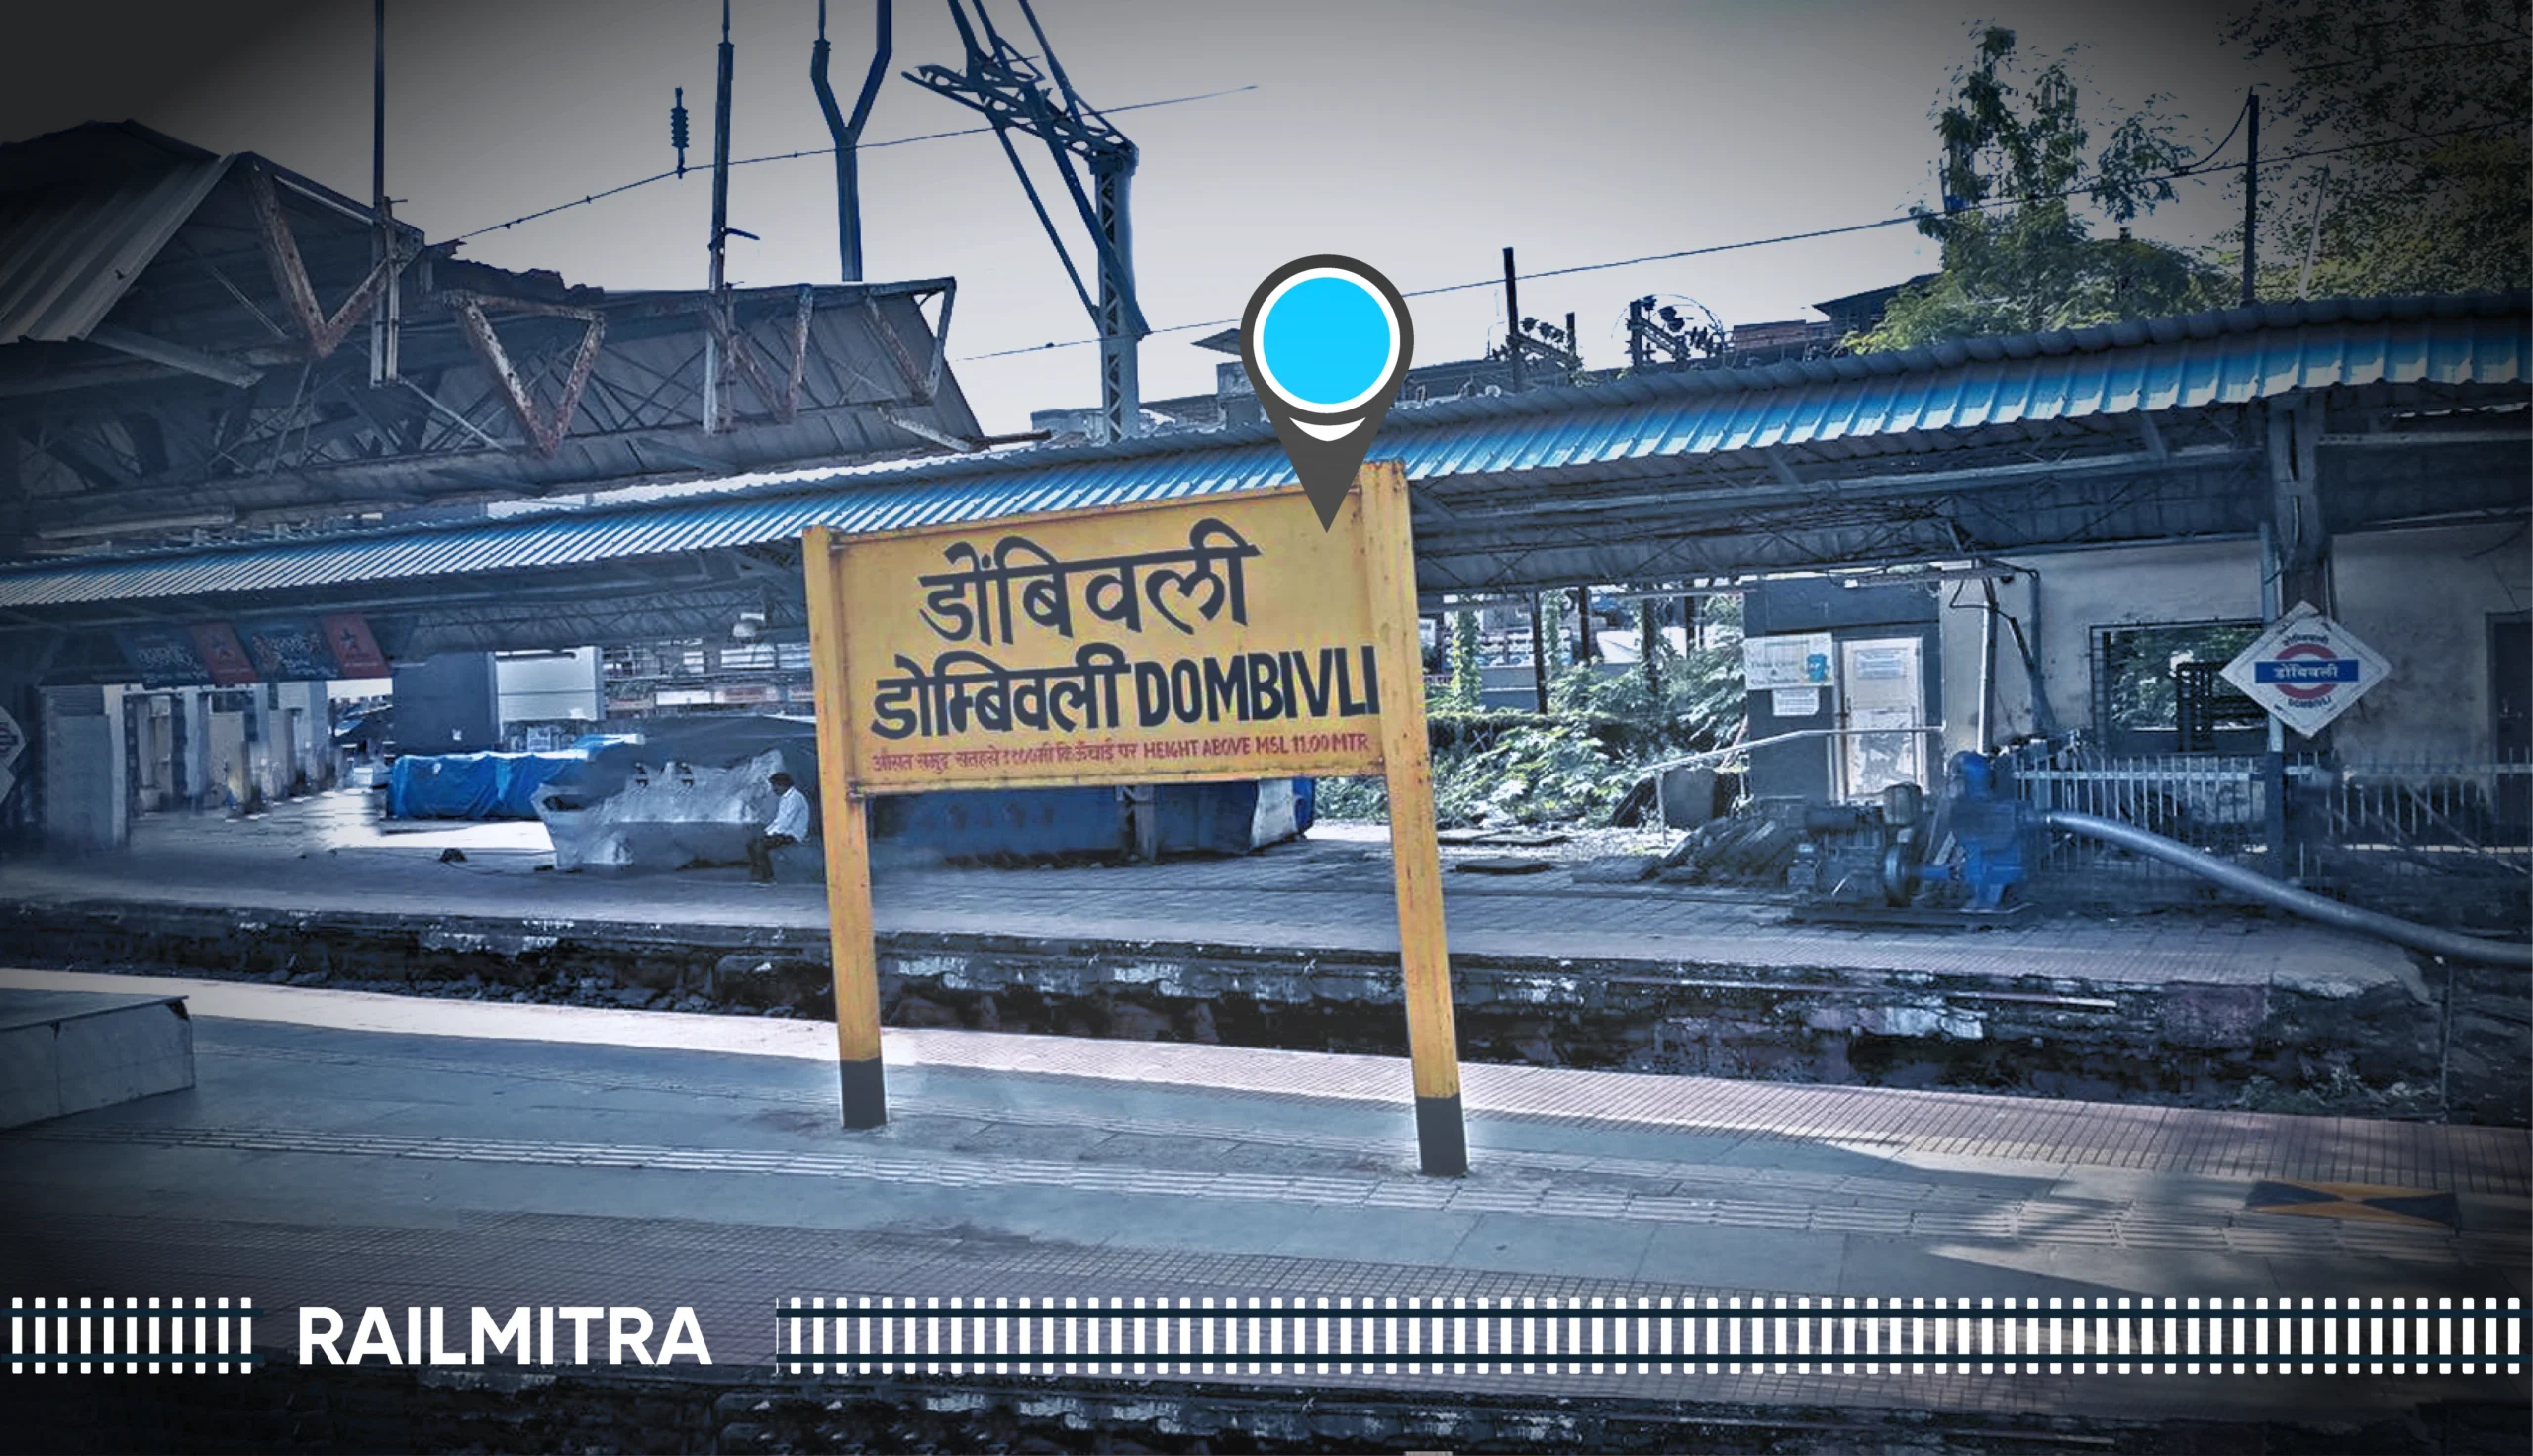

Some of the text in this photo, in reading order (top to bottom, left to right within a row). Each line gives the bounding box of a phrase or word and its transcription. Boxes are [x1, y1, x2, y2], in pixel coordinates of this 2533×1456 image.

[918, 518, 1263, 645] डोंबिवली
[871, 642, 1131, 739] डोम्बिवली
[1136, 645, 1380, 727] DOMBIVLI
[1116, 742, 1138, 759] पर
[1143, 739, 1199, 759] HEIGHT
[1202, 736, 1251, 757] ABOVE
[1255, 735, 1290, 755] MSL
